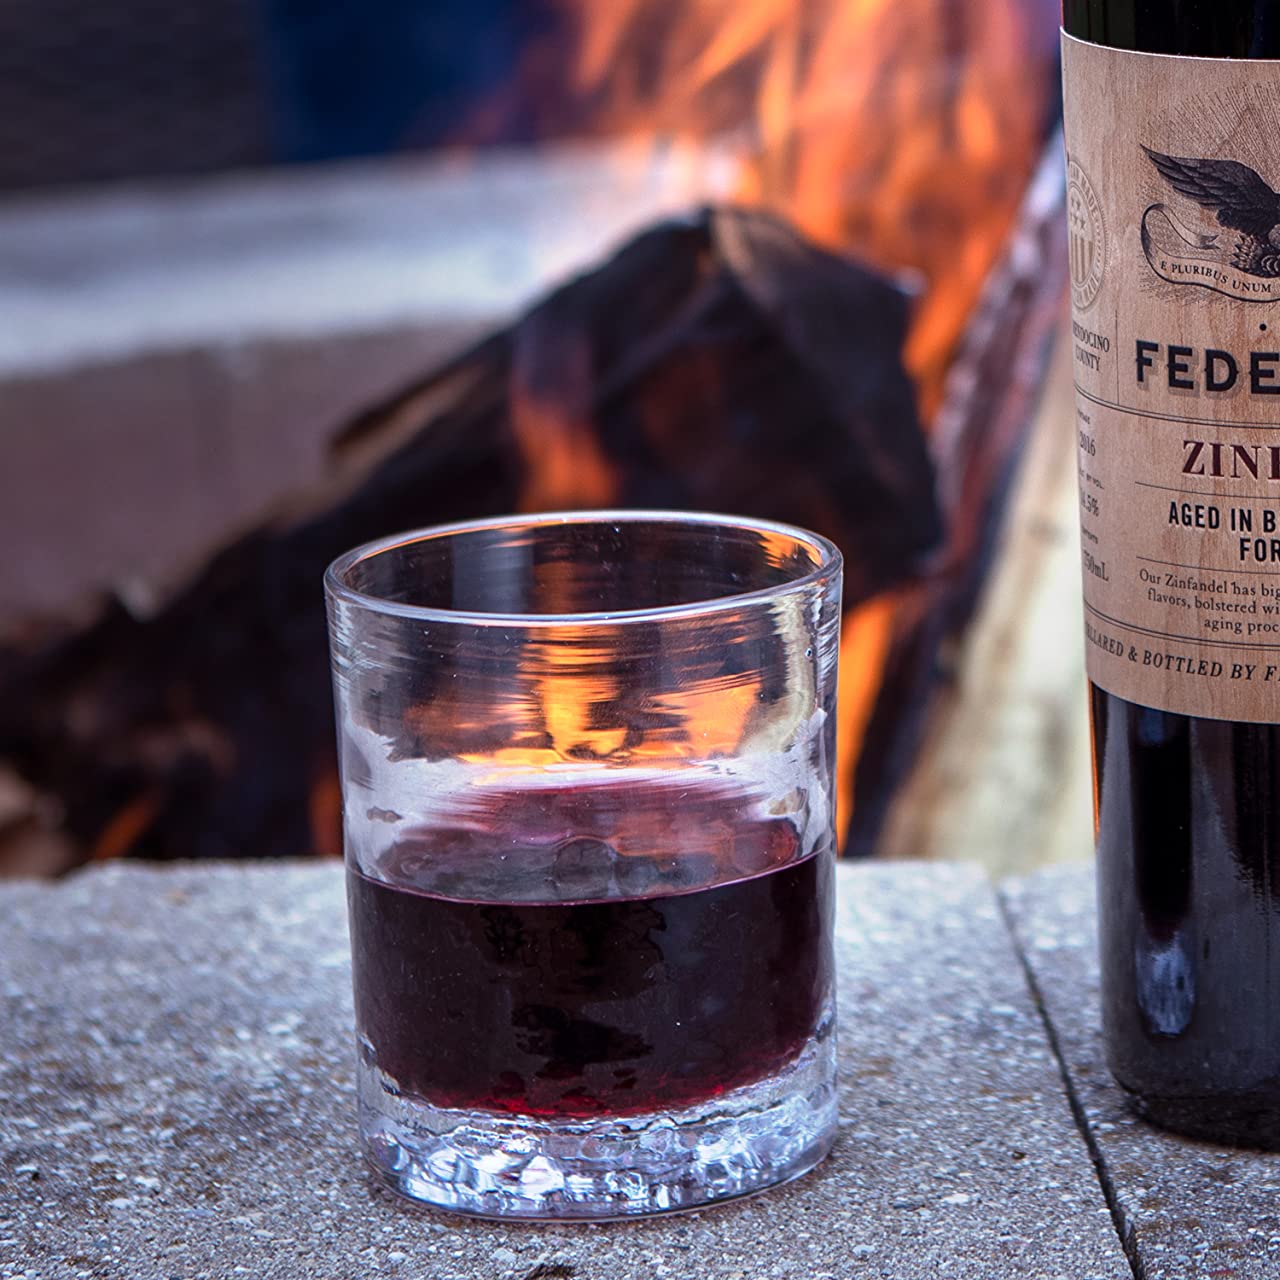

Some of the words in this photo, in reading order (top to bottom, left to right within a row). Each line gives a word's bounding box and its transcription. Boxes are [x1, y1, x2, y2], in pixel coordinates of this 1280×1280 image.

[1160, 260, 1167, 271] E
[1171, 263, 1229, 284] PLURIBUS
[1231, 280, 1272, 293] UNUM
[1168, 501, 1220, 529] AGED
[1230, 508, 1252, 532] IN
[1139, 568, 1161, 585] Our
[1165, 573, 1227, 594] Zinfandel
[1231, 581, 1256, 595] has
[1147, 588, 1191, 609] flavors,
[1194, 596, 1257, 614] bolstered
[1203, 617, 1243, 634] aging
[1086, 624, 1124, 657] ELLARED
[1127, 646, 1138, 663] &
[1142, 649, 1223, 678] BOTTLED
[1230, 663, 1257, 681] BY
